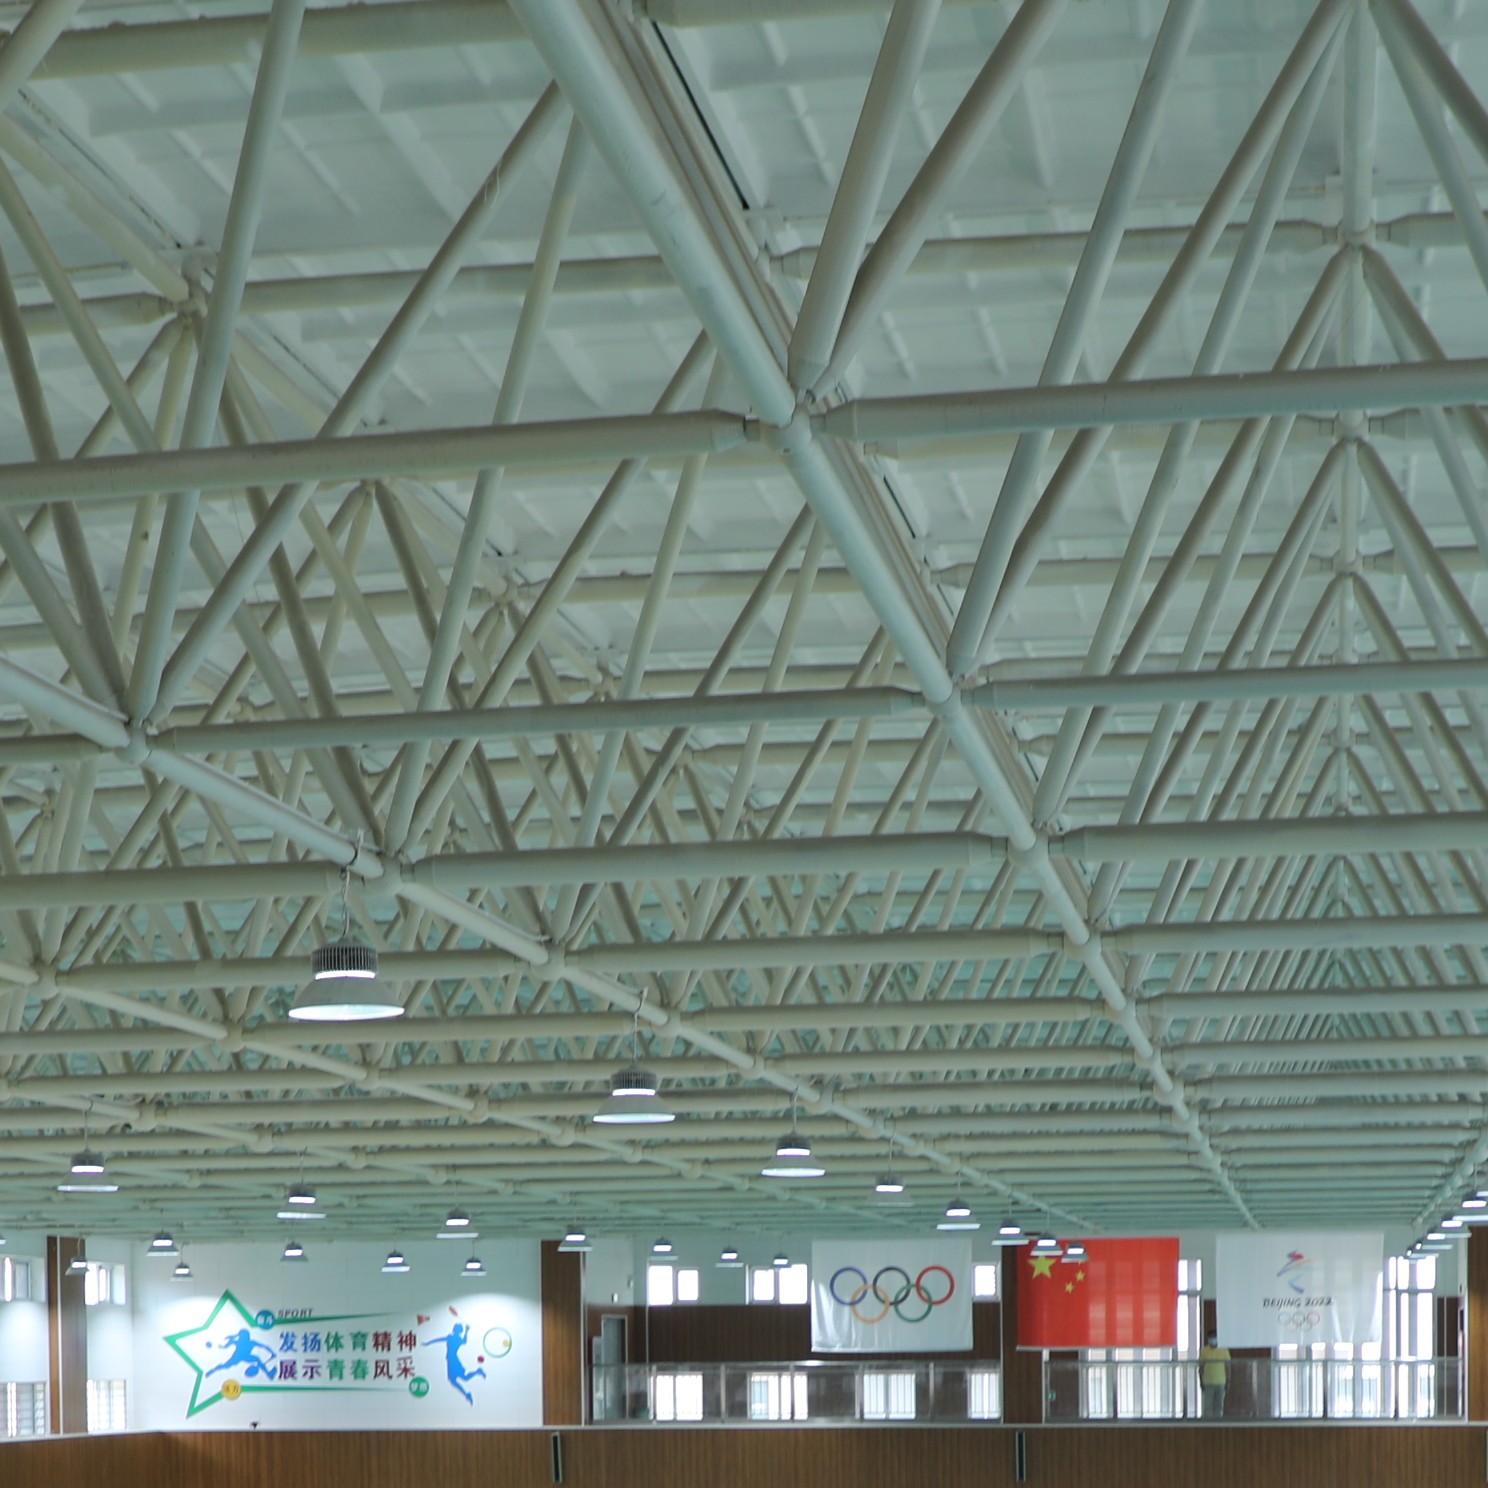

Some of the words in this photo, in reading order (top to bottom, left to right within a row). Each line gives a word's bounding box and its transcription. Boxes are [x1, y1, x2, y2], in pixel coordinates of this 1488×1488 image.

[279, 1330, 417, 1353] 发扬体育精神
[279, 1356, 416, 1380] 展示青春风采
